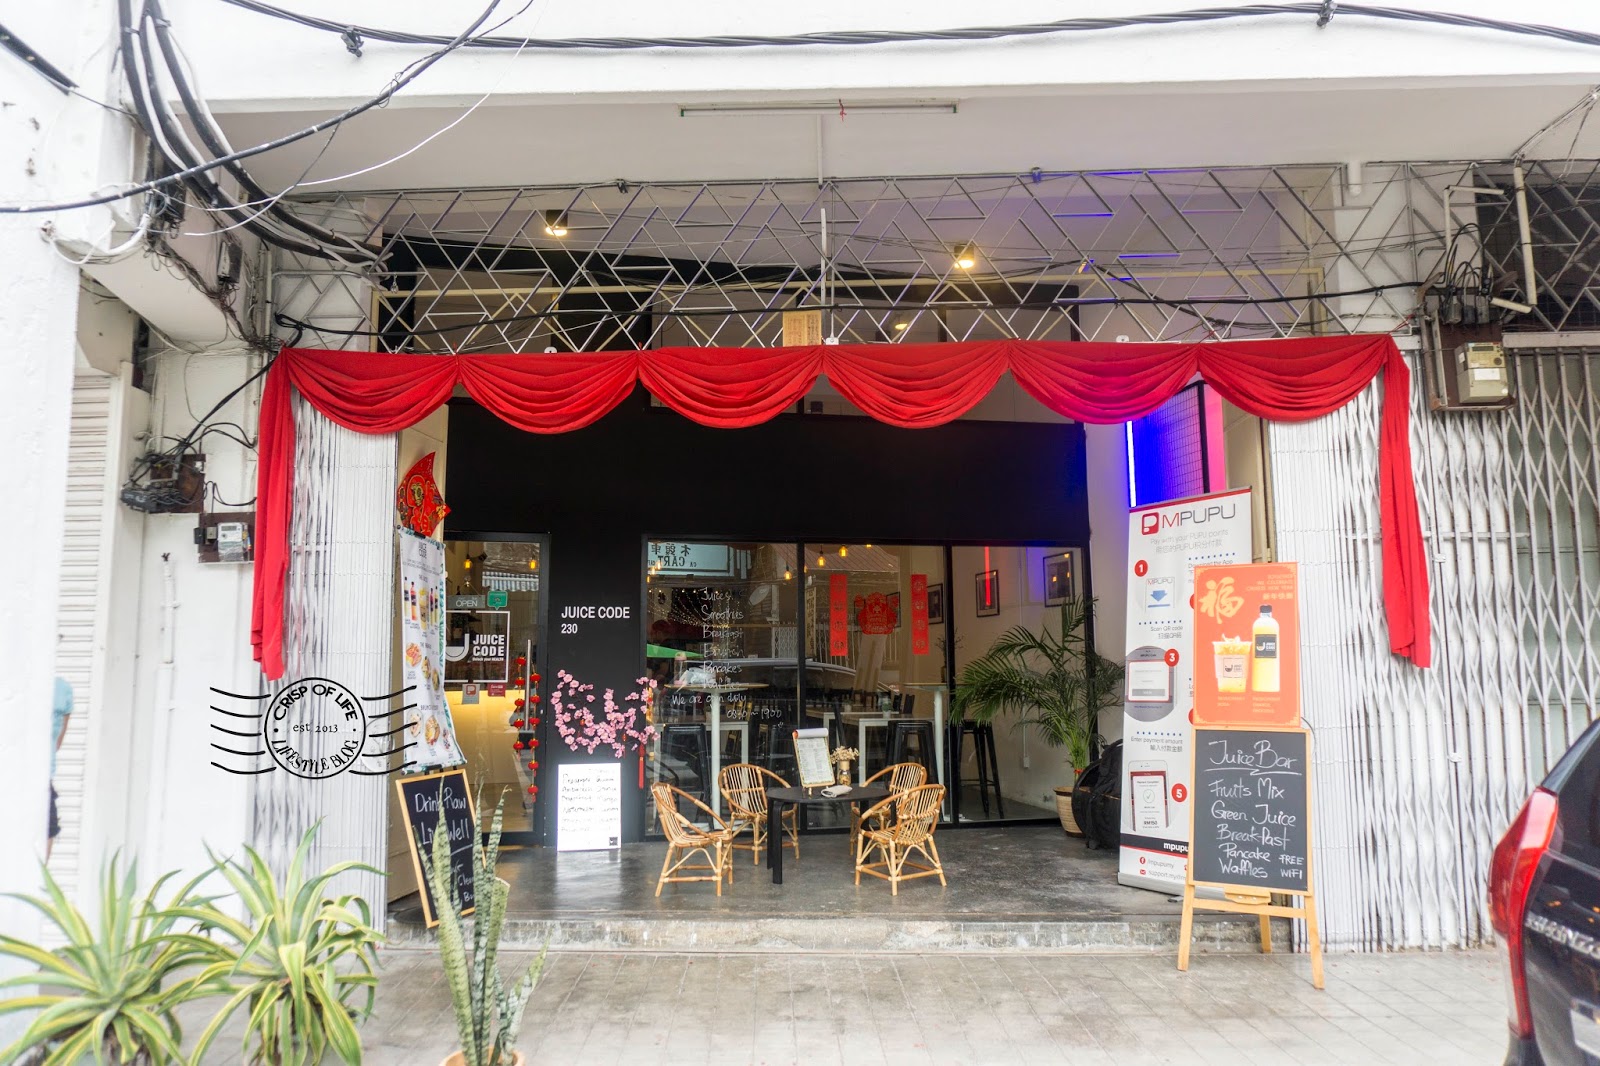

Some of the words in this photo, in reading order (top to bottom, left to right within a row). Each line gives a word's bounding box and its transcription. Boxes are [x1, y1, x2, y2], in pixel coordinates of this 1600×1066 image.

[1162, 503, 1236, 529] MPUPU
[1175, 533, 1189, 543] your
[1190, 530, 1207, 540] PUPU
[1208, 529, 1229, 538] points
[455, 599, 478, 608] OPEN
[561, 606, 596, 619] JUICE
[597, 606, 631, 619] CODE
[561, 623, 578, 634] 230
[472, 634, 505, 645] JUICE
[472, 645, 505, 657] CODE
[672, 694, 686, 705] We
[1208, 739, 1255, 767] Juice
[1253, 739, 1298, 769] Bar
[1208, 777, 1252, 798] Fruits
[1257, 777, 1285, 799] Mix
[1211, 799, 1248, 821] Green
[1251, 804, 1296, 827] Juice
[1218, 842, 1271, 862] Pancake
[1278, 853, 1304, 866] FREE
[1218, 857, 1269, 879] Waffles
[1280, 868, 1303, 880] WIFI
